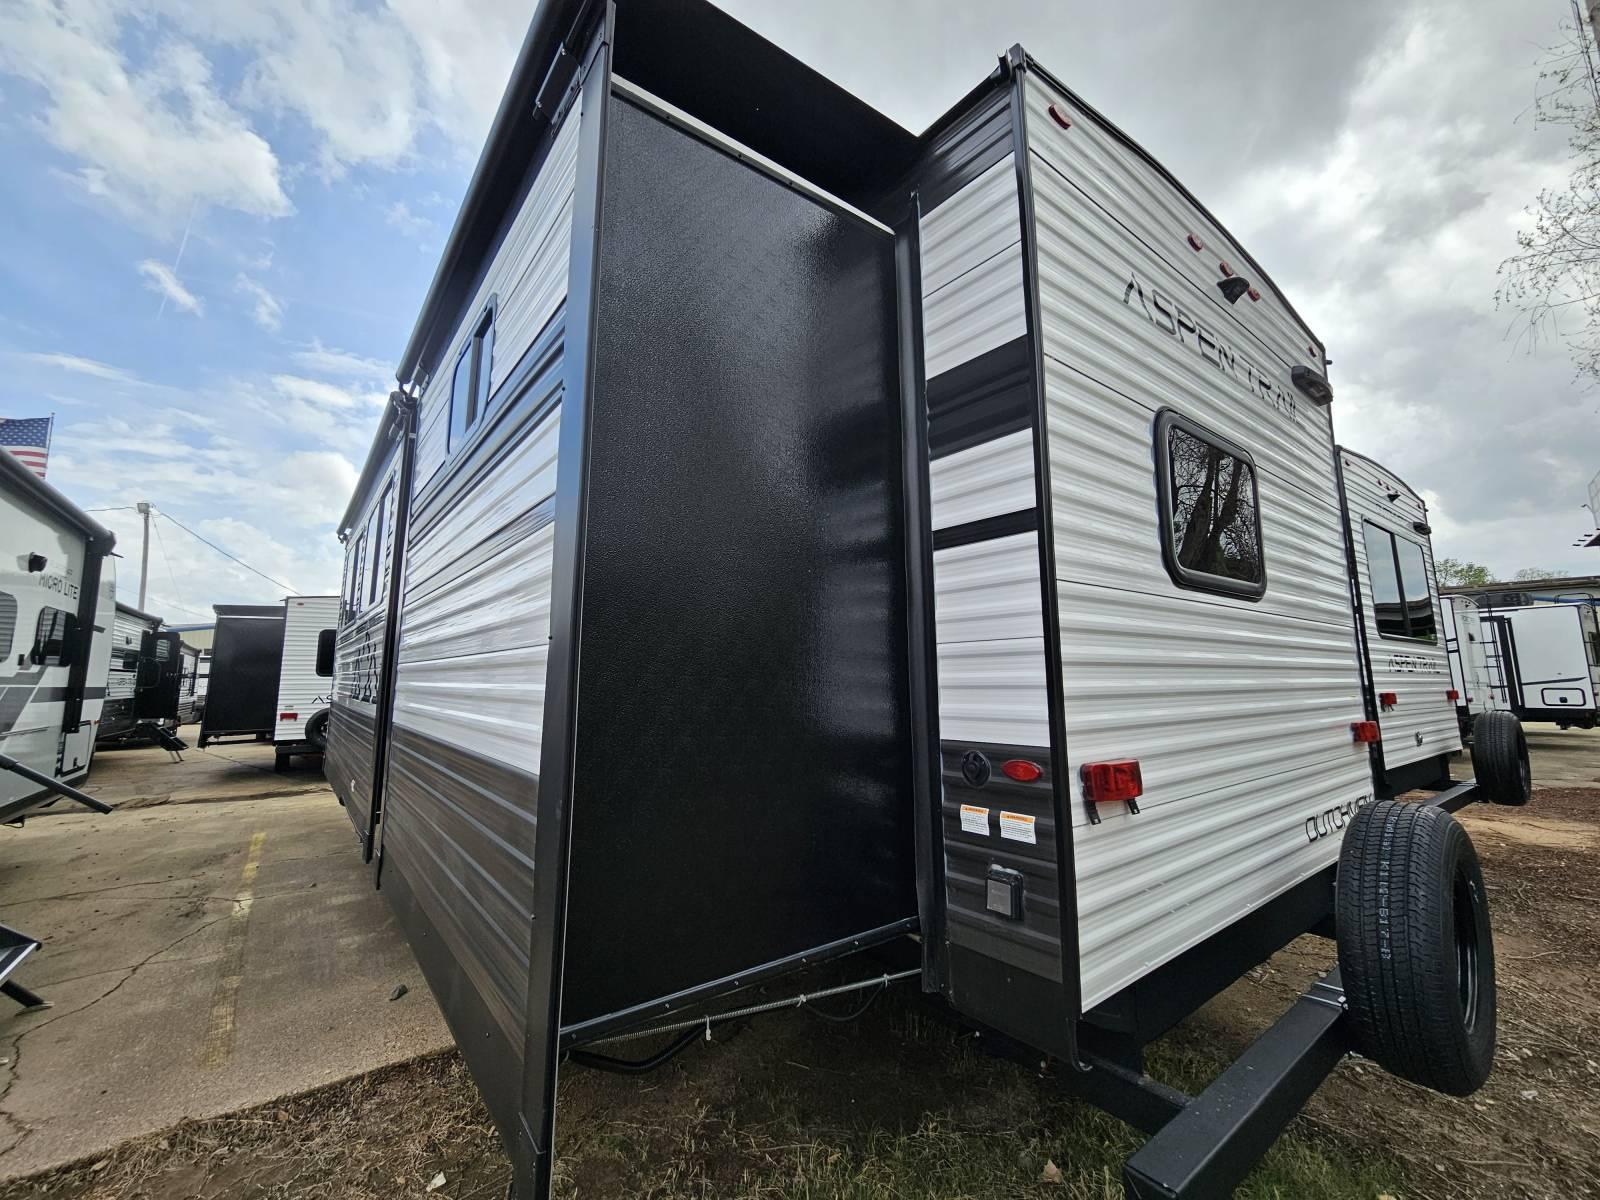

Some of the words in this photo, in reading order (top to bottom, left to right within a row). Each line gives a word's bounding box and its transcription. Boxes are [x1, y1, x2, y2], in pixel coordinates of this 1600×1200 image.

[1123, 271, 1238, 383] ASPEN
[1239, 354, 1304, 428] TRAIL
[39, 573, 63, 593] MICRO
[64, 581, 79, 600] LITE
[1389, 654, 1416, 673] ASPEN
